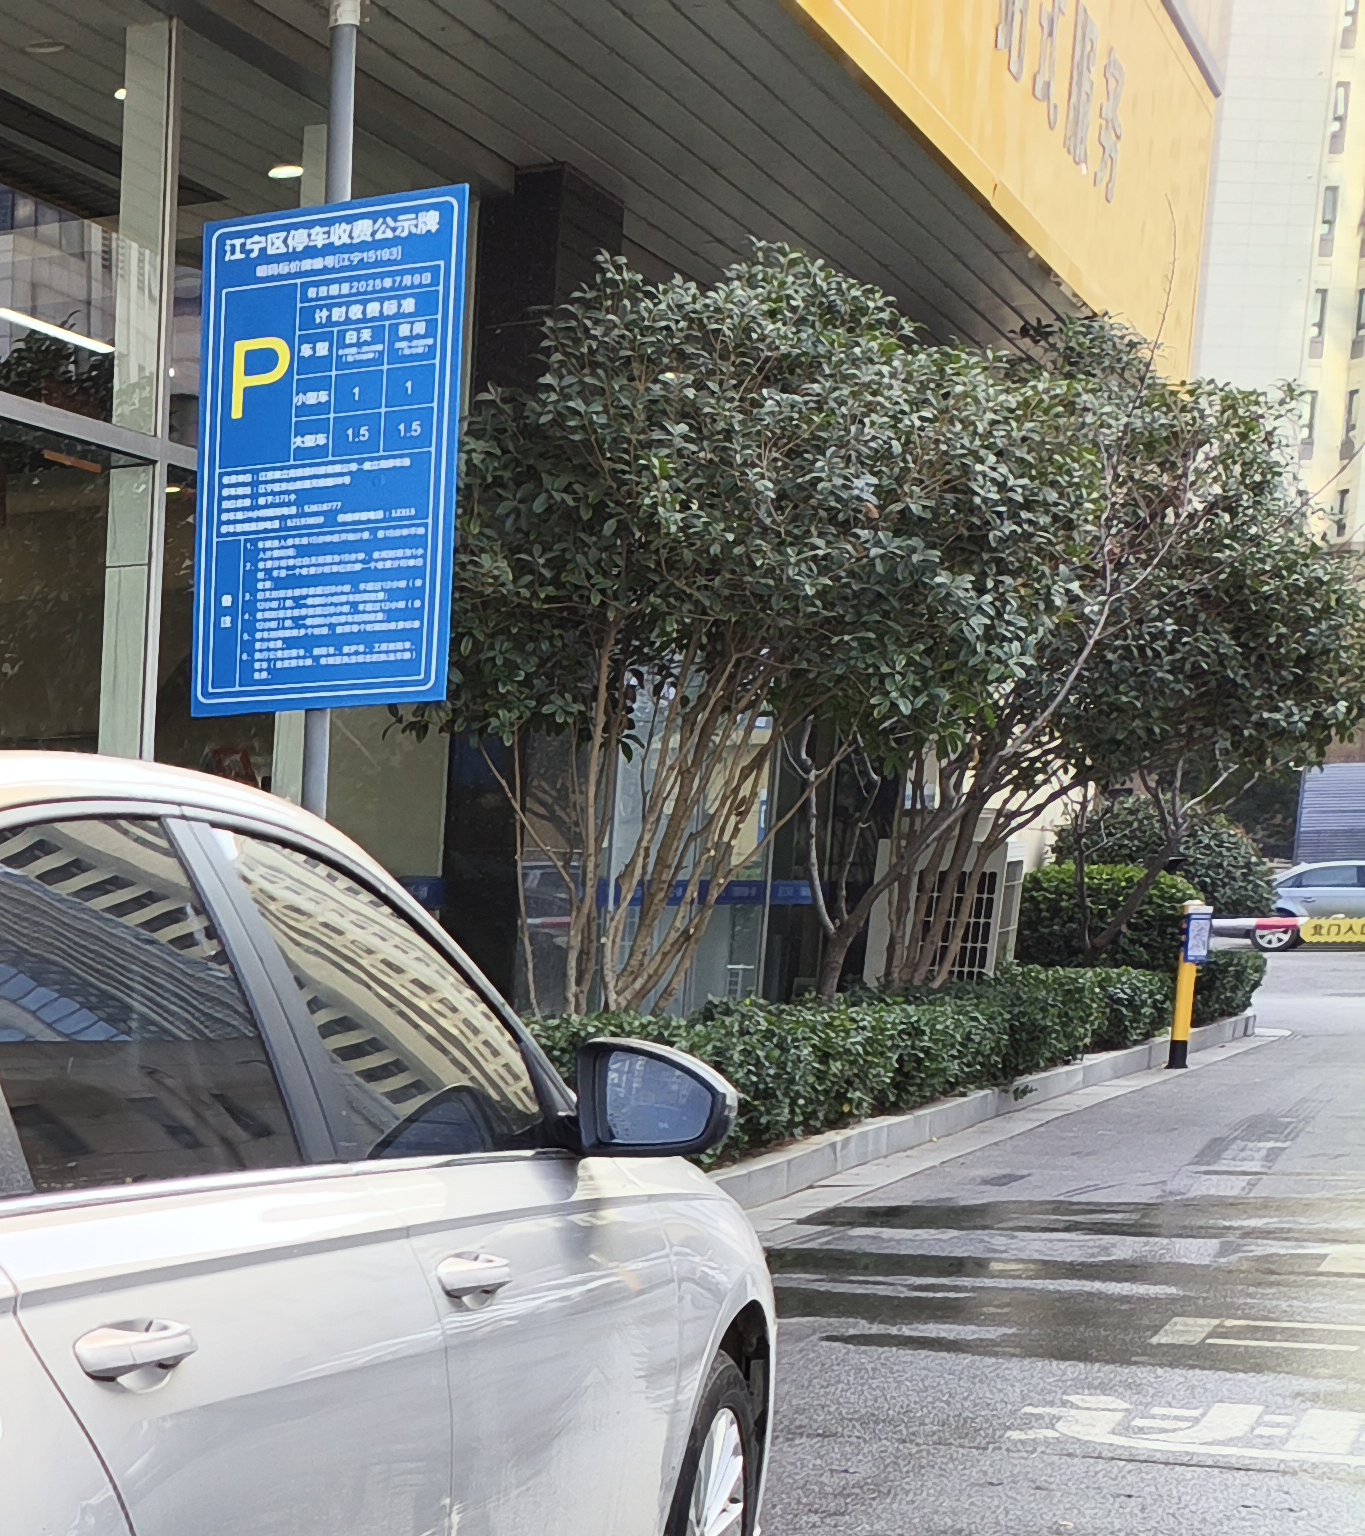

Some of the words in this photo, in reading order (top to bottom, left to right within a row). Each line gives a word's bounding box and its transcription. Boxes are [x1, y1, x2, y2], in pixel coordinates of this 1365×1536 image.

[224, 209, 440, 261] 江宁区停车收费公示牌
[314, 297, 416, 325] 计时收费标准
[345, 328, 373, 345] 白天
[299, 341, 330, 358] 车型
[231, 336, 291, 420] P
[352, 386, 361, 402] 1
[404, 380, 413, 396] 1
[295, 390, 330, 407] 小型车
[346, 425, 370, 444] 1.5
[397, 420, 422, 438] 1.5
[293, 432, 328, 449] 大型车
